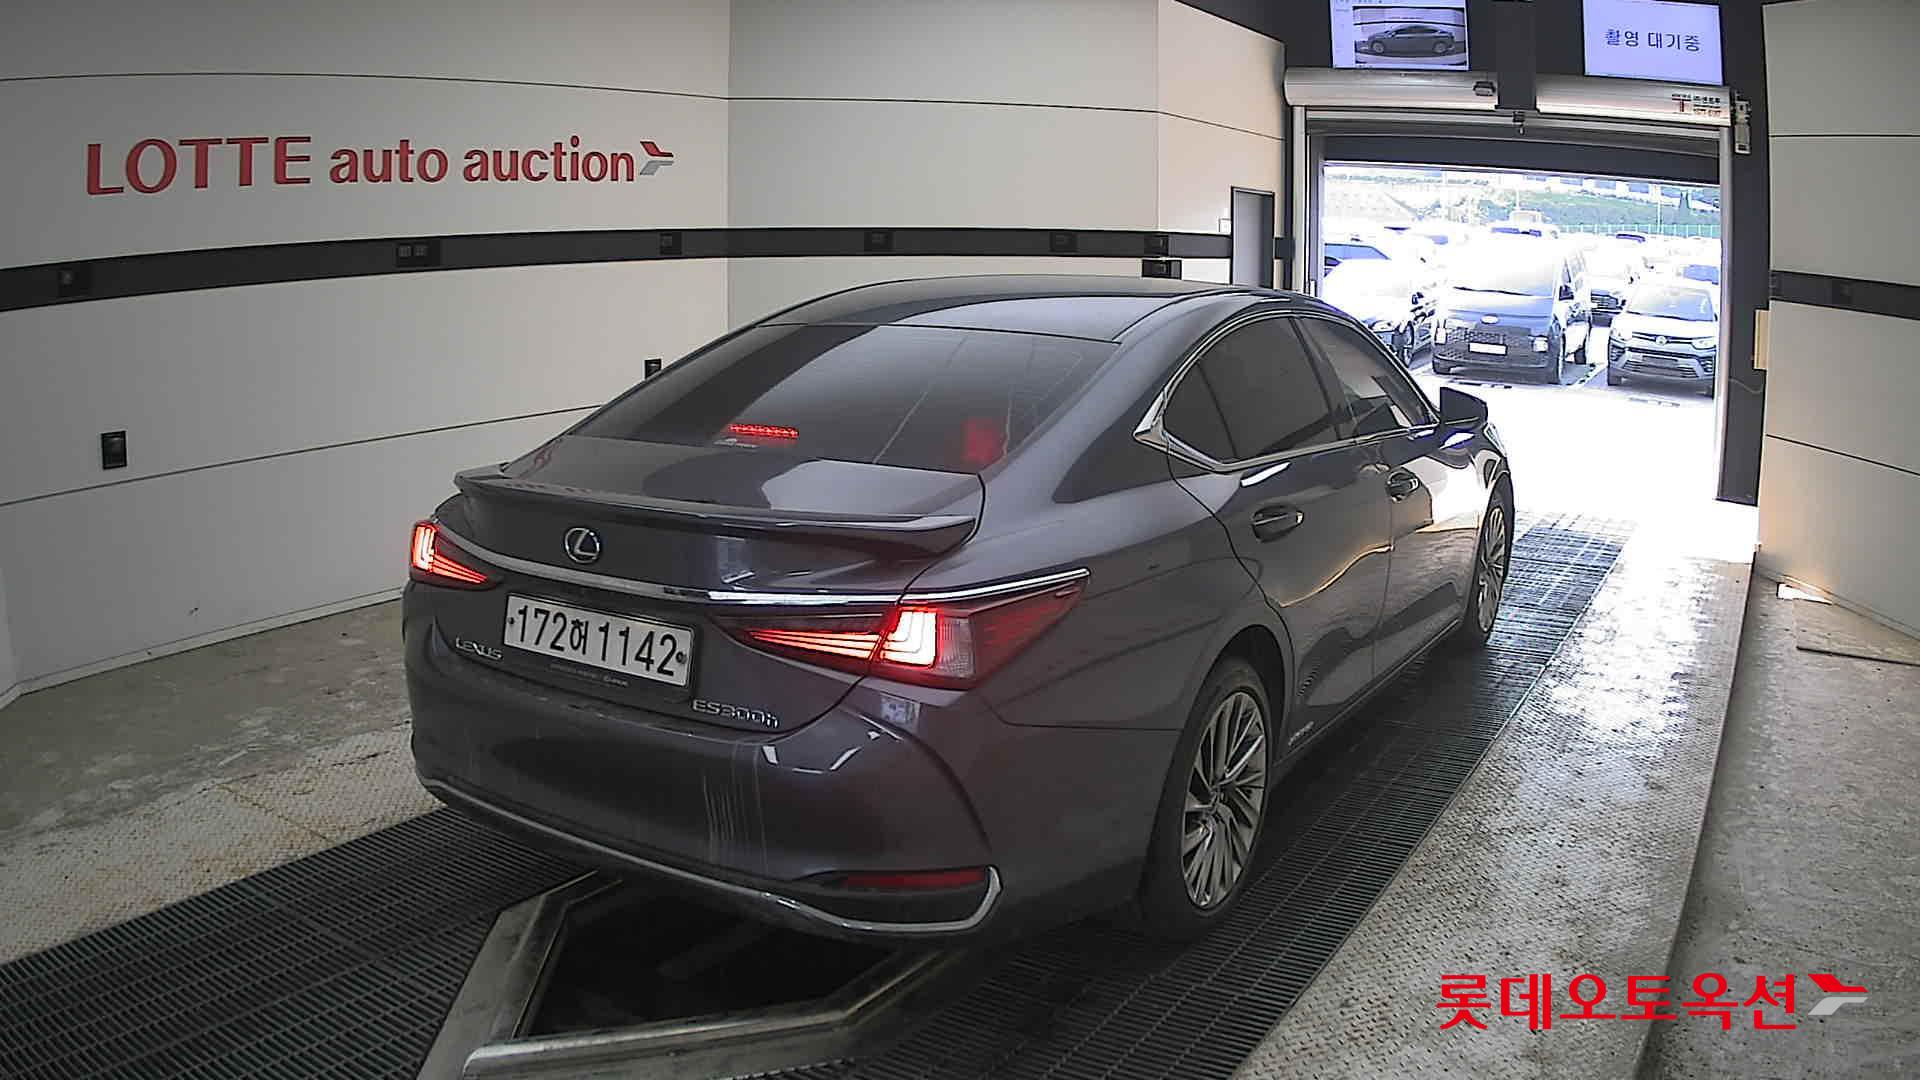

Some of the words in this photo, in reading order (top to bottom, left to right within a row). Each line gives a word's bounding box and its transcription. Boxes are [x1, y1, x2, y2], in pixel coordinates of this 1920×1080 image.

[1647, 32, 1701, 53] 대기중
[86, 136, 311, 195] LOTTE
[329, 139, 449, 184] auto
[462, 135, 635, 183] auction
[455, 636, 503, 661] LEXUS
